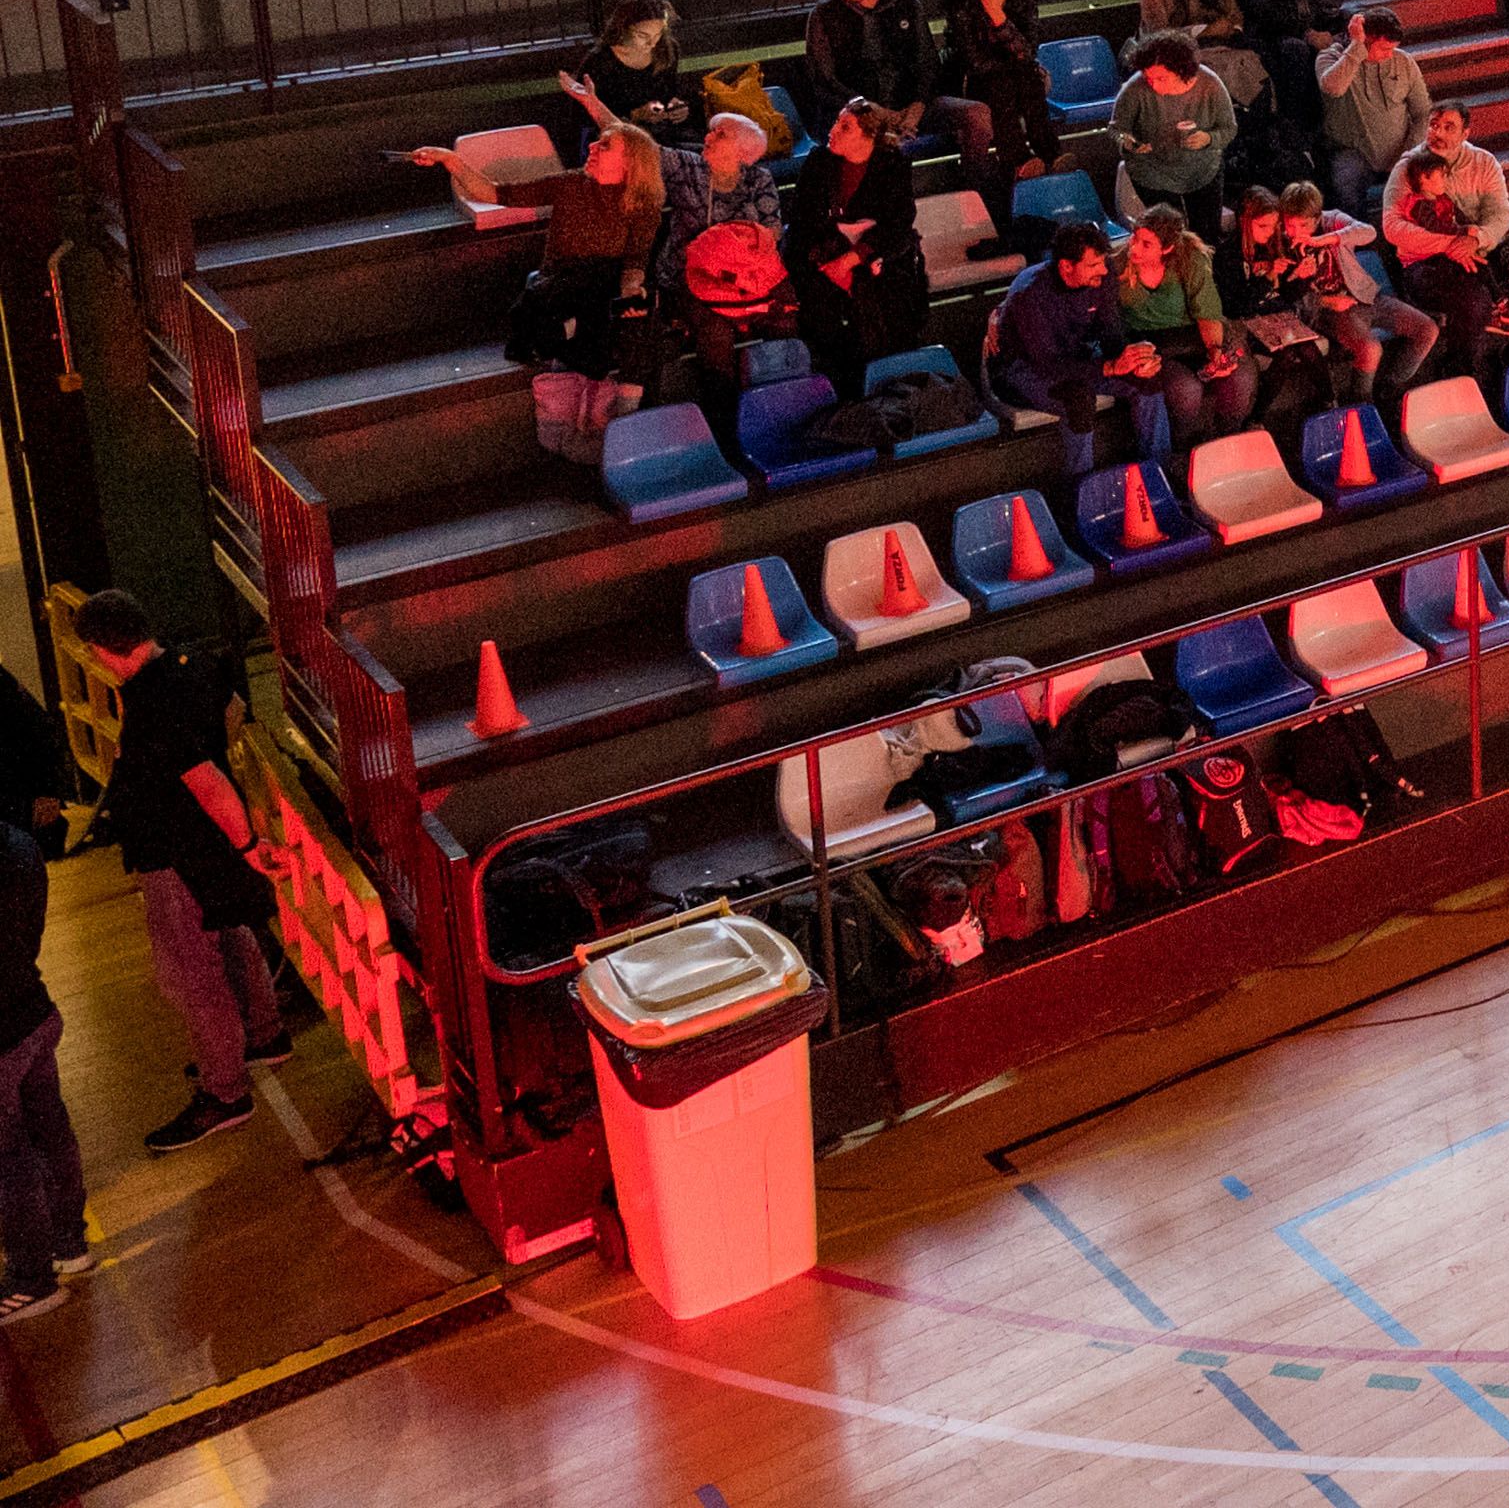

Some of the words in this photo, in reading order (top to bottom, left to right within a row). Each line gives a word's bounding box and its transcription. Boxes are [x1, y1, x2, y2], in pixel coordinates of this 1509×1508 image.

[1136, 482, 1151, 524] FORZA
[888, 550, 907, 593] FORZA
[1232, 798, 1253, 839] SPALDING
